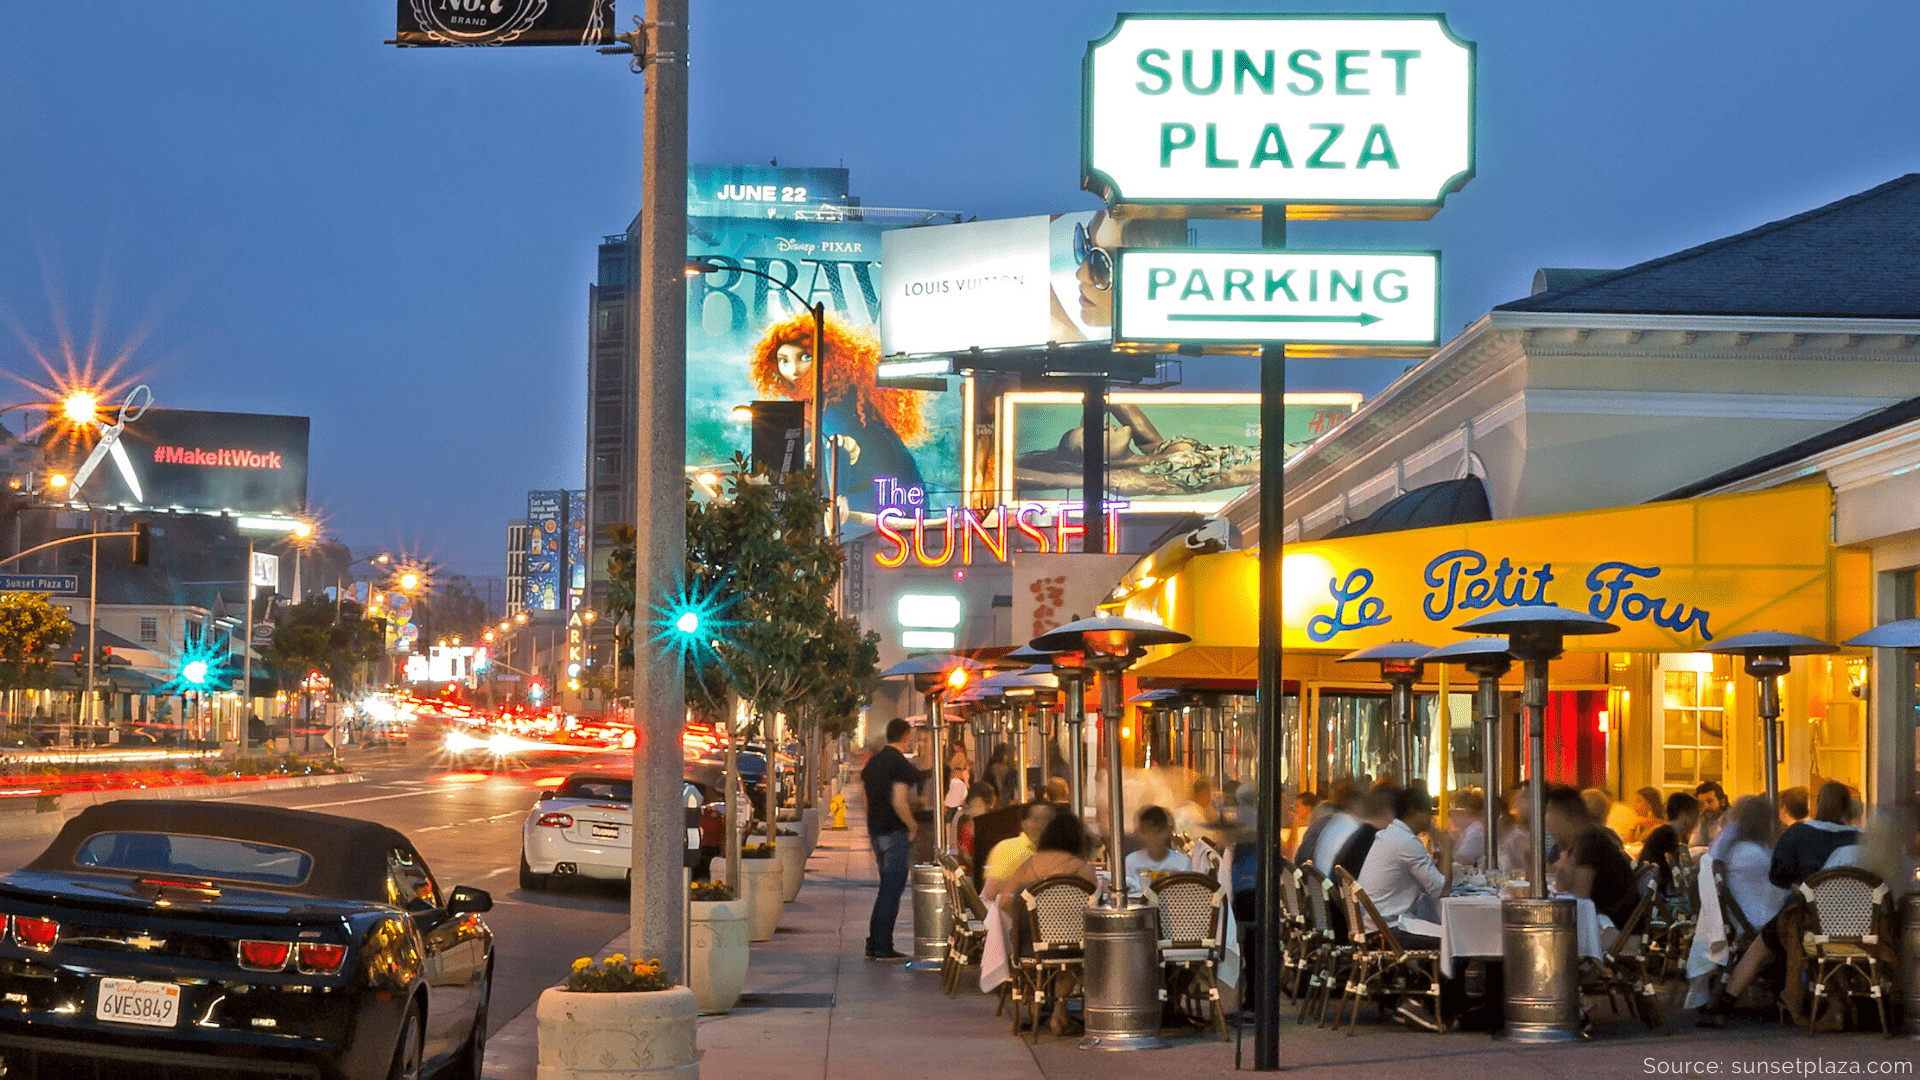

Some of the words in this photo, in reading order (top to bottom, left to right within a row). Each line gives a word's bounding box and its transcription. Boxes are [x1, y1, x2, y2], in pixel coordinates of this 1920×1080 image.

[450, 15, 488, 26] BRAND
[1135, 48, 1422, 96] SUNSET
[1159, 121, 1401, 170] PLAZA
[717, 184, 777, 202] JUNE
[781, 187, 807, 202] 22
[774, 236, 816, 256] Disney
[821, 242, 862, 253] PIXAR
[687, 255, 882, 336] BRAV
[904, 280, 949, 297] LOUIS
[955, 275, 1024, 291] VUIN
[1147, 267, 1410, 304] PARKING
[154, 446, 282, 469] #MakeItWork
[874, 477, 925, 505] The
[875, 500, 1131, 568] SUNSET
[5, 579, 35, 588] Sunset
[38, 579, 62, 588] Plaza
[64, 579, 75, 588] Dr
[1307, 568, 1393, 643] Le
[1422, 548, 1558, 622] Petit
[1586, 561, 1713, 641] Four
[103, 994, 172, 1018] 6VES849
